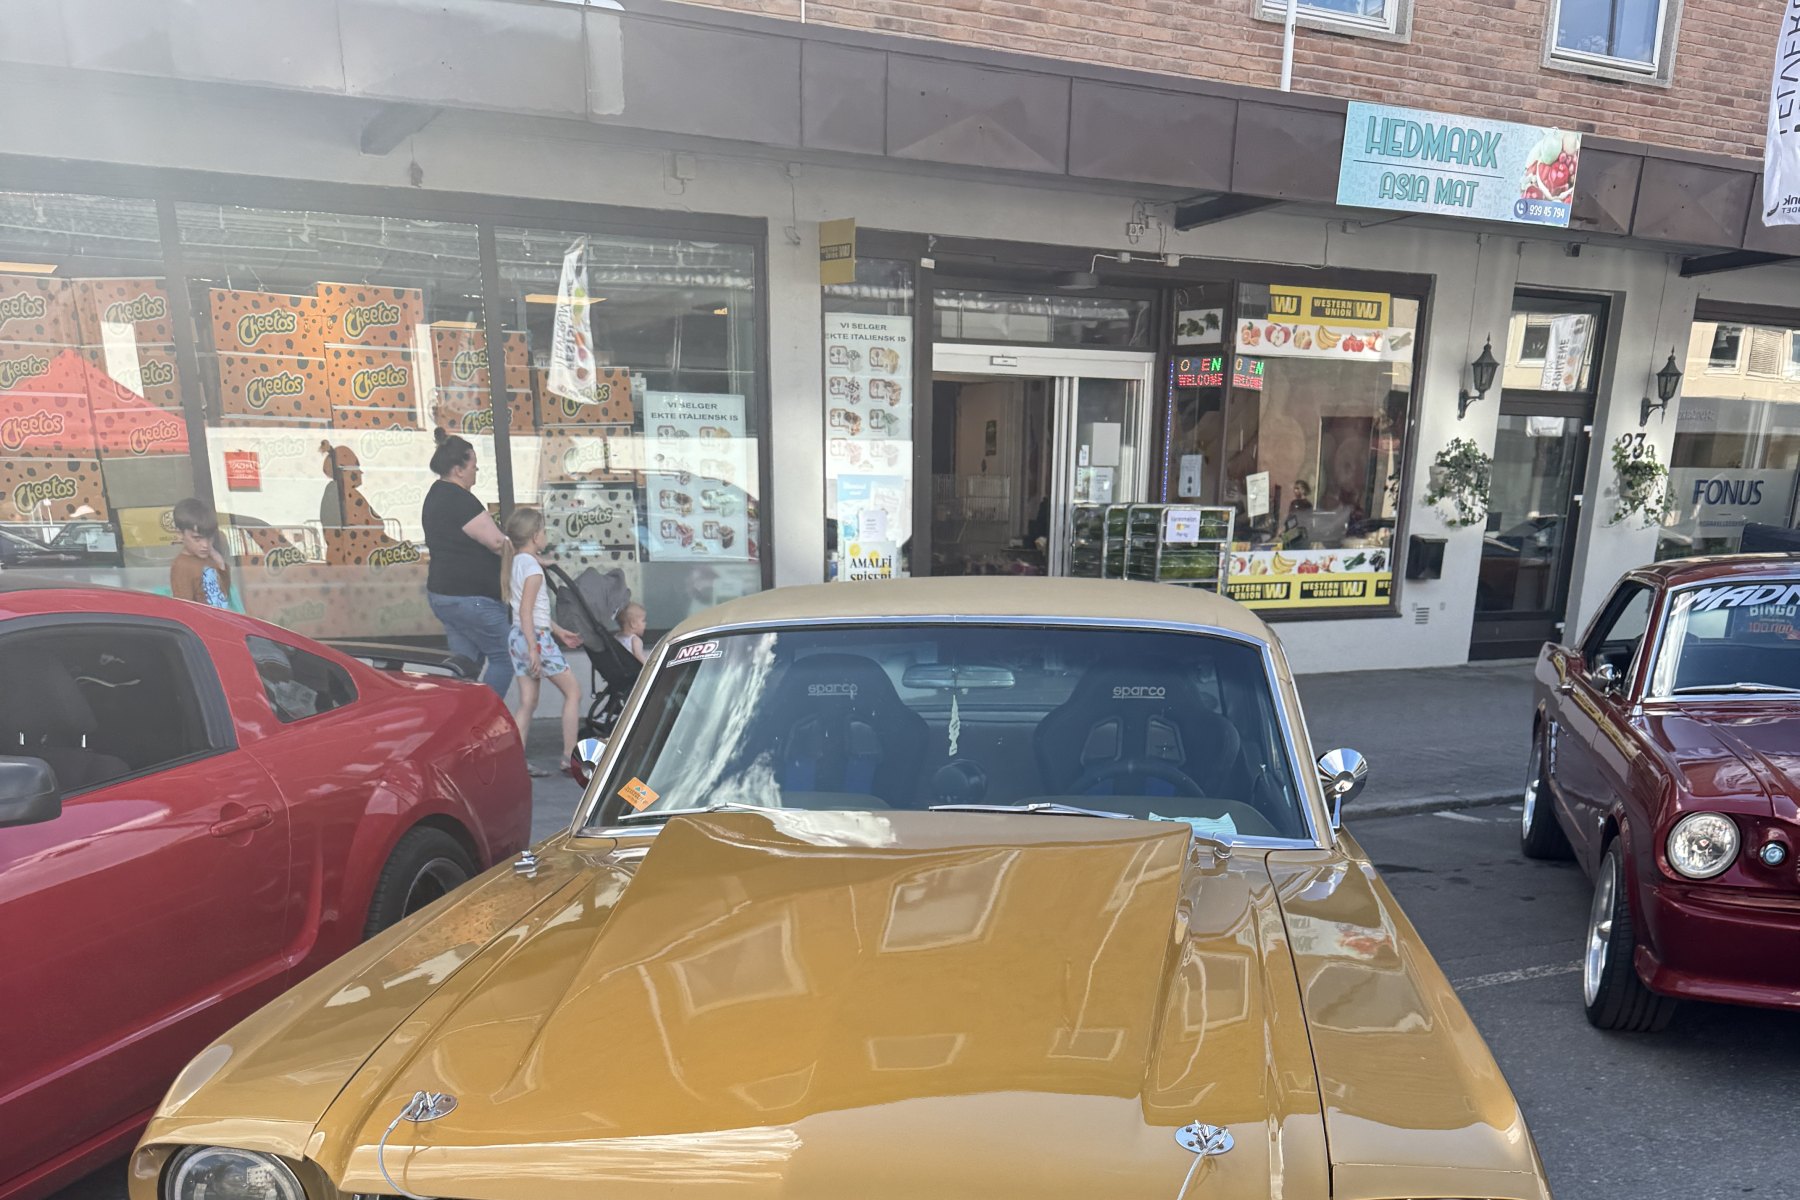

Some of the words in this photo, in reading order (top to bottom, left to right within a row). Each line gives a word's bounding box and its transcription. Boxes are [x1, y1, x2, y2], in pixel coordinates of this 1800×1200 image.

[1365, 116, 1502, 169] HEDMARK
[1379, 172, 1429, 203] ASIA
[1434, 177, 1479, 208] MAT
[105, 295, 166, 333] Cheetos
[1275, 296, 1298, 314] WU
[1313, 298, 1353, 308] WESTERN
[1355, 302, 1378, 319] WU
[1325, 308, 1352, 317] UNION
[239, 310, 296, 346] Cheetos
[346, 302, 399, 338] Cheetos
[852, 322, 887, 331] SELGER
[851, 333, 896, 342] ITALIENSK
[455, 349, 488, 380] Chee
[1180, 357, 1222, 372] OEN
[1235, 358, 1264, 375] OEN
[354, 364, 407, 400] Cheetos
[1178, 373, 1223, 386] WELCOME
[247, 372, 303, 408] Cheetos
[679, 401, 718, 410] SELGER
[651, 412, 677, 420] EKTE
[679, 413, 727, 421] ITALIENSK
[2, 412, 63, 449] Cheetos
[131, 422, 179, 454] Cheetos
[15, 476, 76, 513] Cheetos
[1692, 479, 1764, 506] FONUS
[566, 505, 613, 538] Cheetos
[369, 542, 420, 575] Cheetos
[1234, 592, 1261, 600] UNION
[1264, 583, 1288, 599] WU
[1302, 582, 1340, 591] WESTERN
[1342, 581, 1364, 597] WU
[1313, 589, 1338, 597] UNION
[1749, 604, 1797, 617] BINGO
[808, 683, 858, 697] sparco
[1112, 686, 1166, 699] sparco
